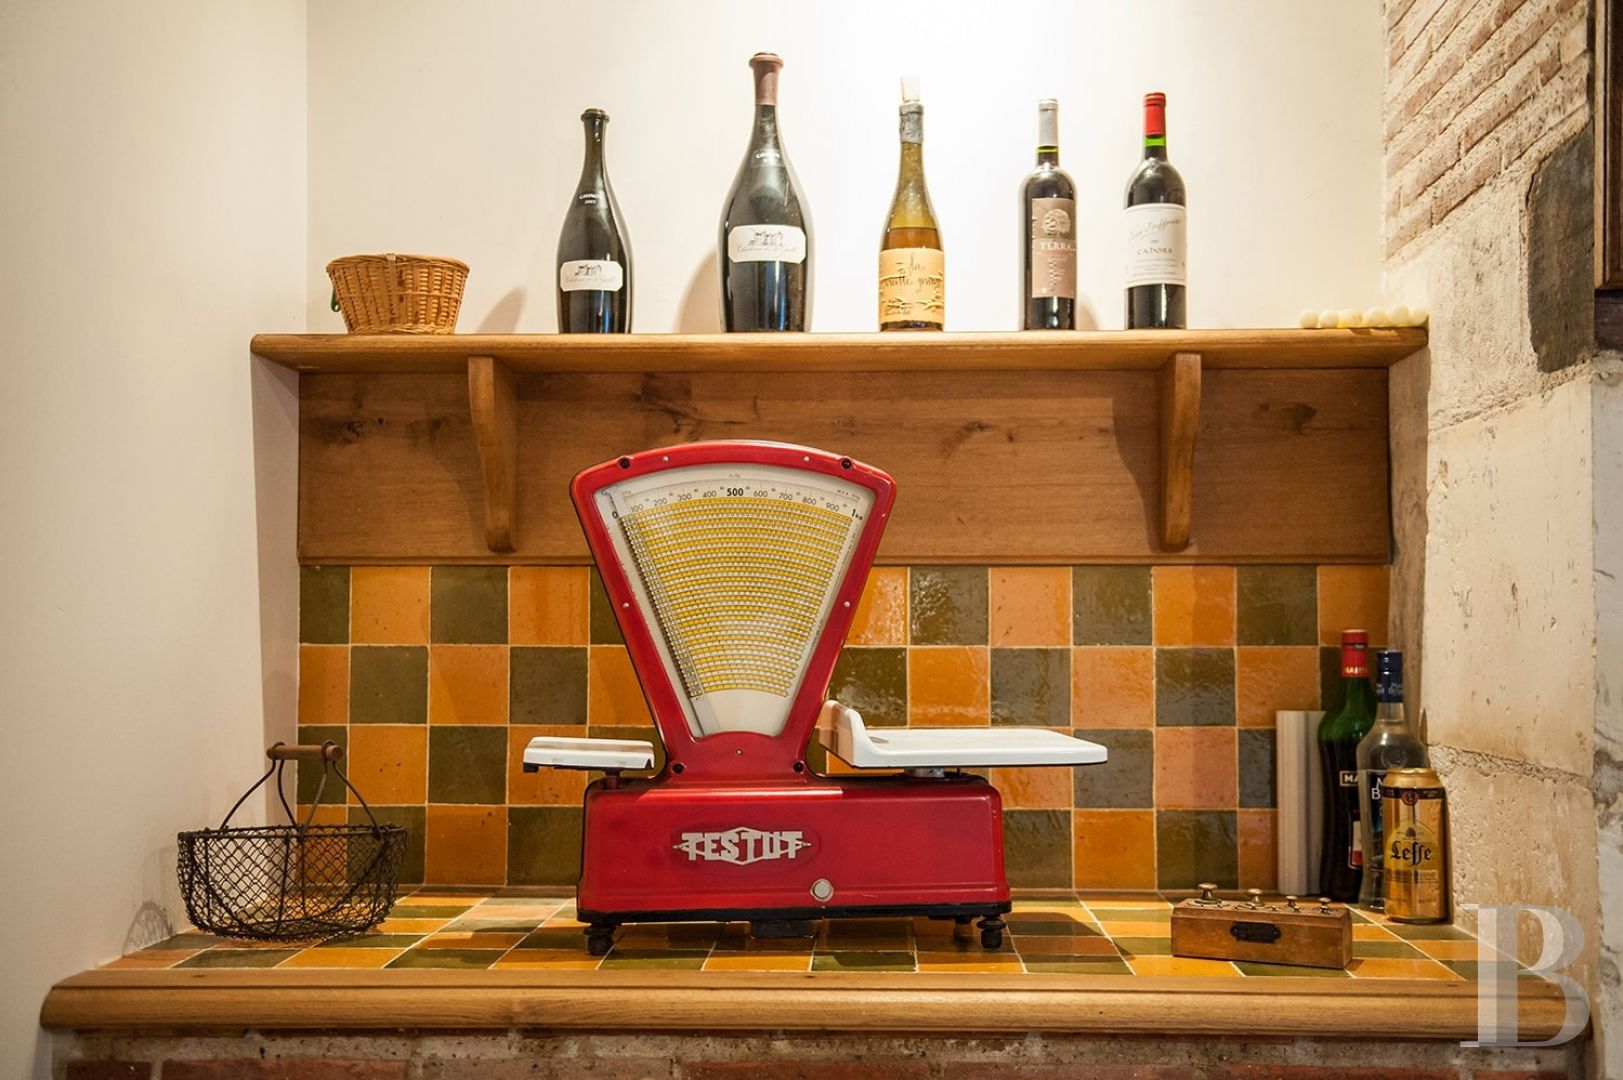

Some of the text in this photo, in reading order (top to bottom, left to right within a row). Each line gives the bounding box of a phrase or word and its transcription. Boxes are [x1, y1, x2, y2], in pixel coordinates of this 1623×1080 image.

[630, 503, 644, 513] 100
[653, 497, 668, 507] 200
[677, 493, 692, 502] 300
[702, 490, 717, 498] 400
[726, 487, 744, 497] 500
[753, 490, 768, 498] 600
[778, 493, 793, 501] 700
[802, 497, 817, 506] 800
[825, 502, 840, 512] 900
[681, 831, 803, 861] TESTUT
[1391, 841, 1432, 866] Leffe
